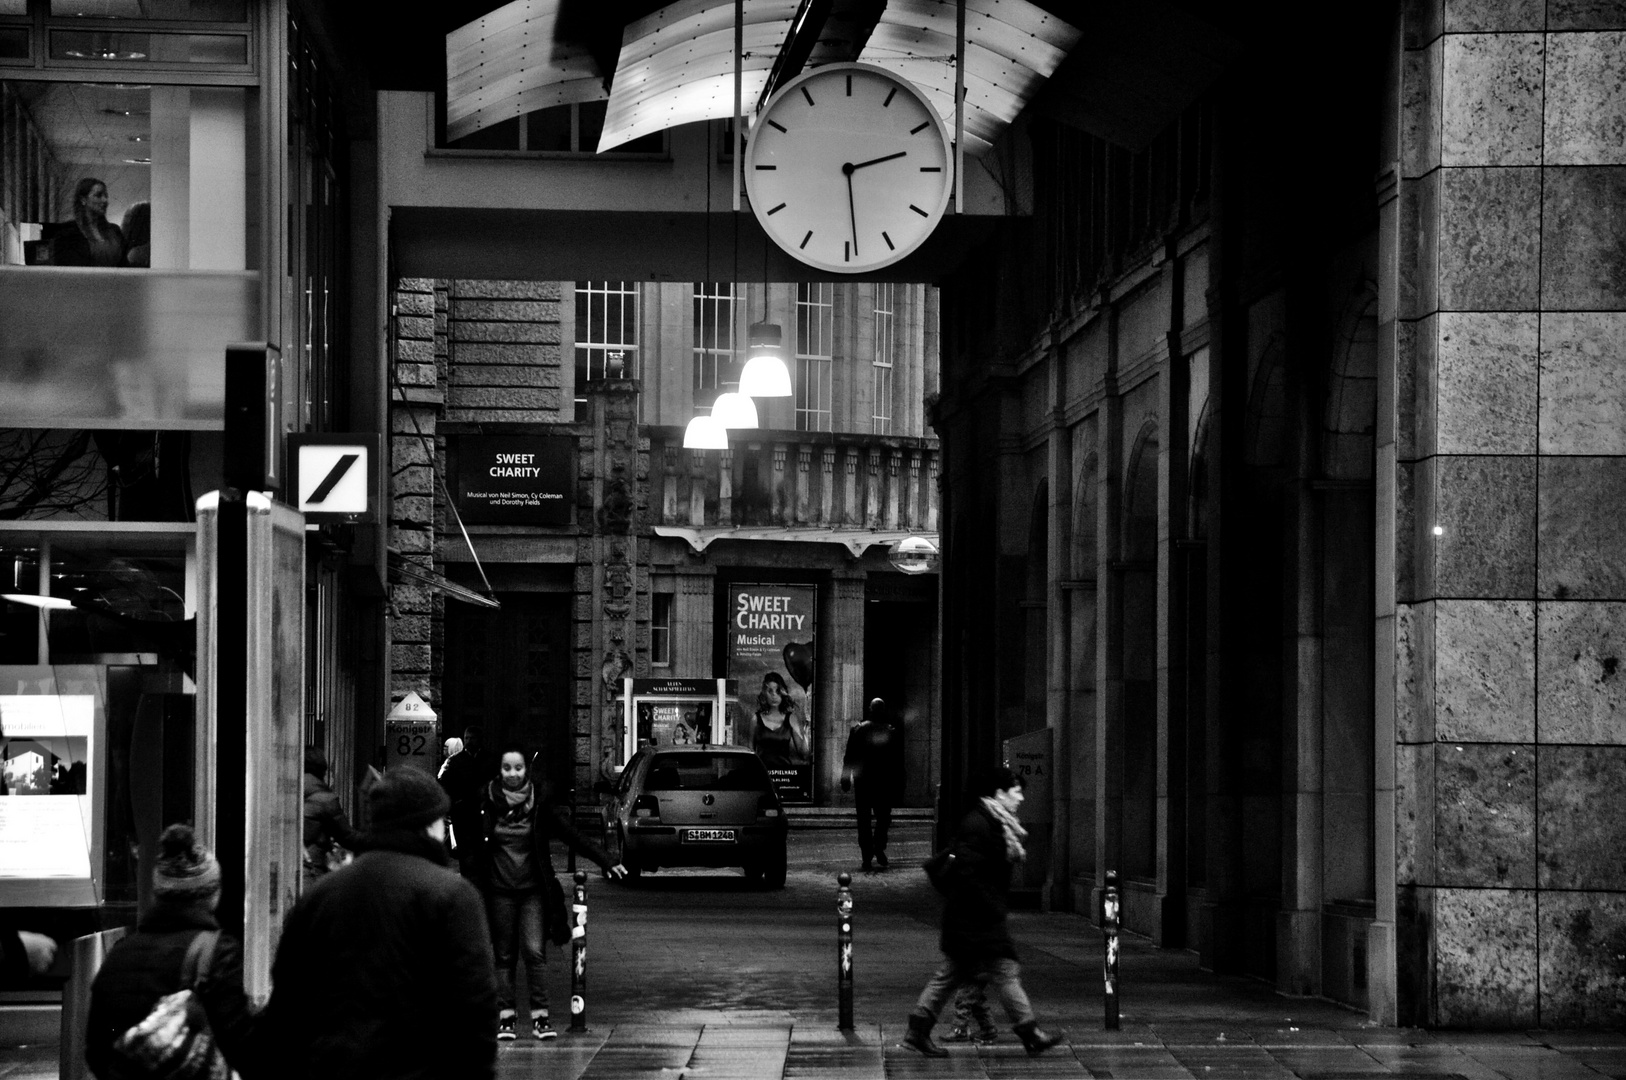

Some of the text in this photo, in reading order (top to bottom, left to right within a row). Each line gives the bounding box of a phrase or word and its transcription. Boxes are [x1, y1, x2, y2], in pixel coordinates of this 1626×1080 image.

[495, 453, 535, 464] SWEET
[489, 466, 541, 477] CHARITY
[511, 492, 529, 500] Simon,
[530, 492, 538, 500] Cy
[501, 498, 524, 506] Dorothy
[737, 592, 791, 612] SWEET
[736, 610, 805, 630] CHARITY
[737, 634, 775, 645] Musical
[405, 703, 419, 712] 82
[653, 706, 675, 714] SWEET
[653, 713, 681, 721] CHARITY
[397, 735, 426, 755] 82
[1019, 764, 1044, 775] 78 A
